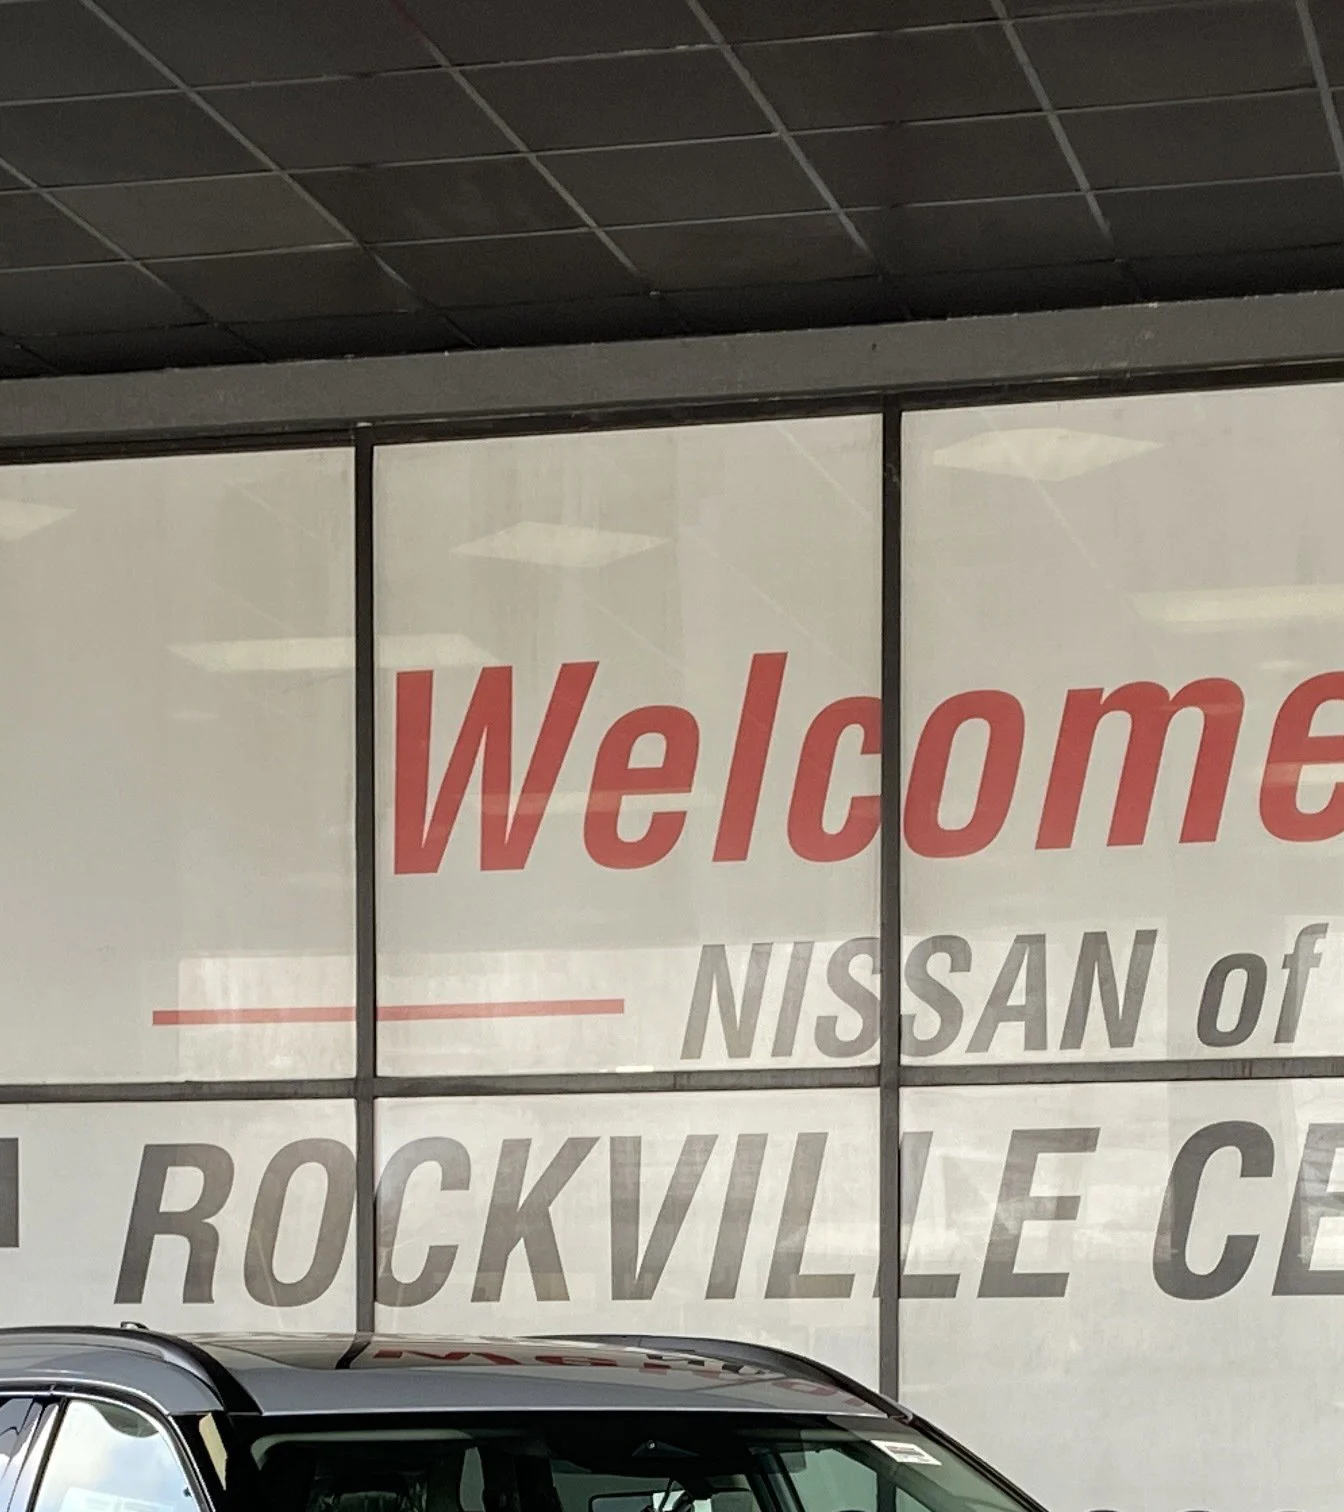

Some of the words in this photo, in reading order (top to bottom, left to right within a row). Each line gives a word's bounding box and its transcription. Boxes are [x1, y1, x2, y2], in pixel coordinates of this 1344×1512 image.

[679, 928, 1160, 1061] NISSAN
[1196, 922, 1330, 1047] of
[113, 1126, 1101, 1308] ROCKVILLE
